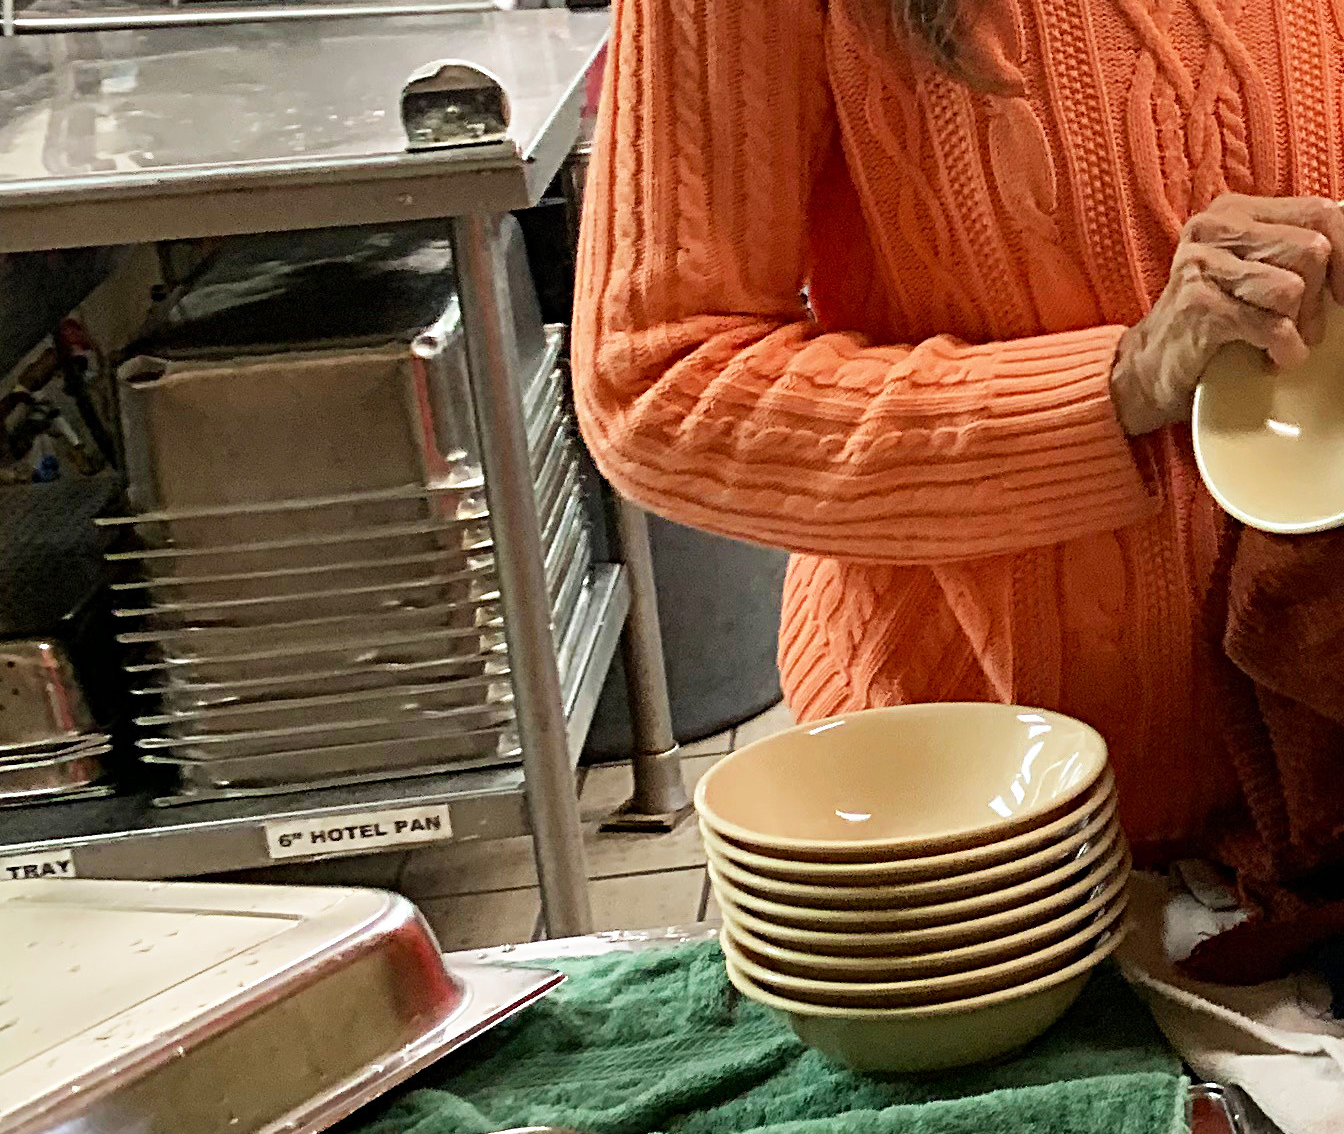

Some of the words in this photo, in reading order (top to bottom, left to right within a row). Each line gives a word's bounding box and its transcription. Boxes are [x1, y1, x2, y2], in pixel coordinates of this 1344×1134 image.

[311, 824, 388, 843] HOTEL
[394, 815, 441, 834] PAN
[6, 860, 70, 879] TRAY
